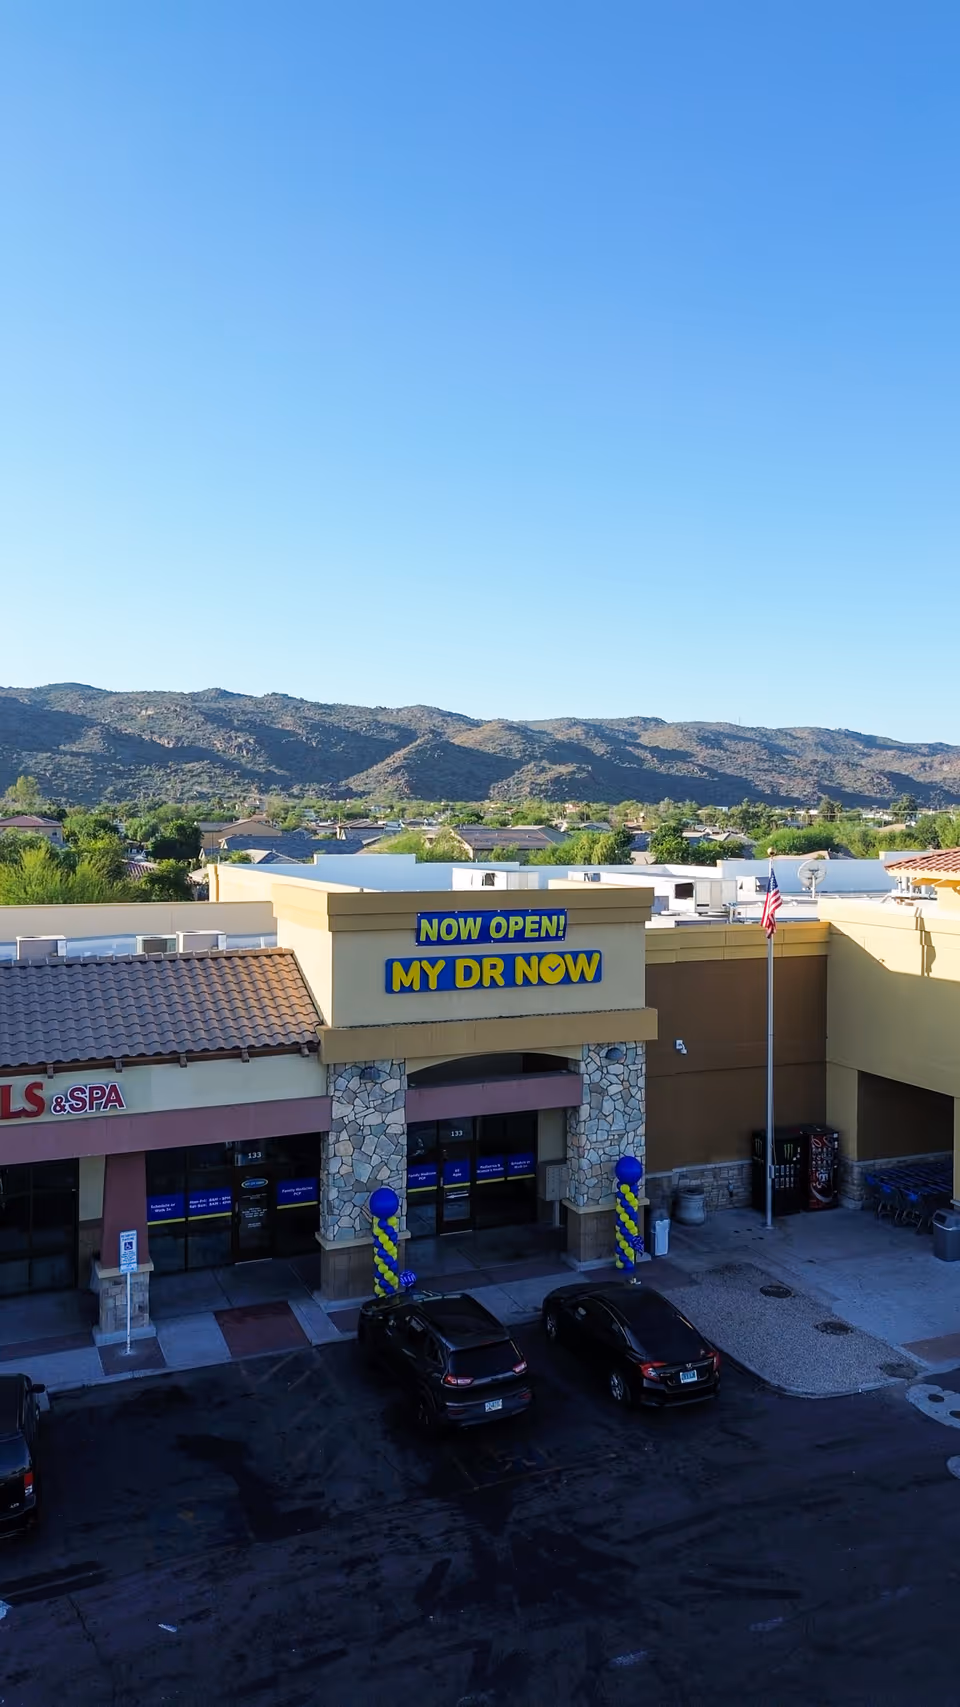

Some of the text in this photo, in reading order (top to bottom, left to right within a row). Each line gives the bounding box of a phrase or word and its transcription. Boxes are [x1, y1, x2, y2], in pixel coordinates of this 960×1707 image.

[419, 915, 565, 941] NOW OPEN!
[392, 952, 600, 992] MY DR NOW
